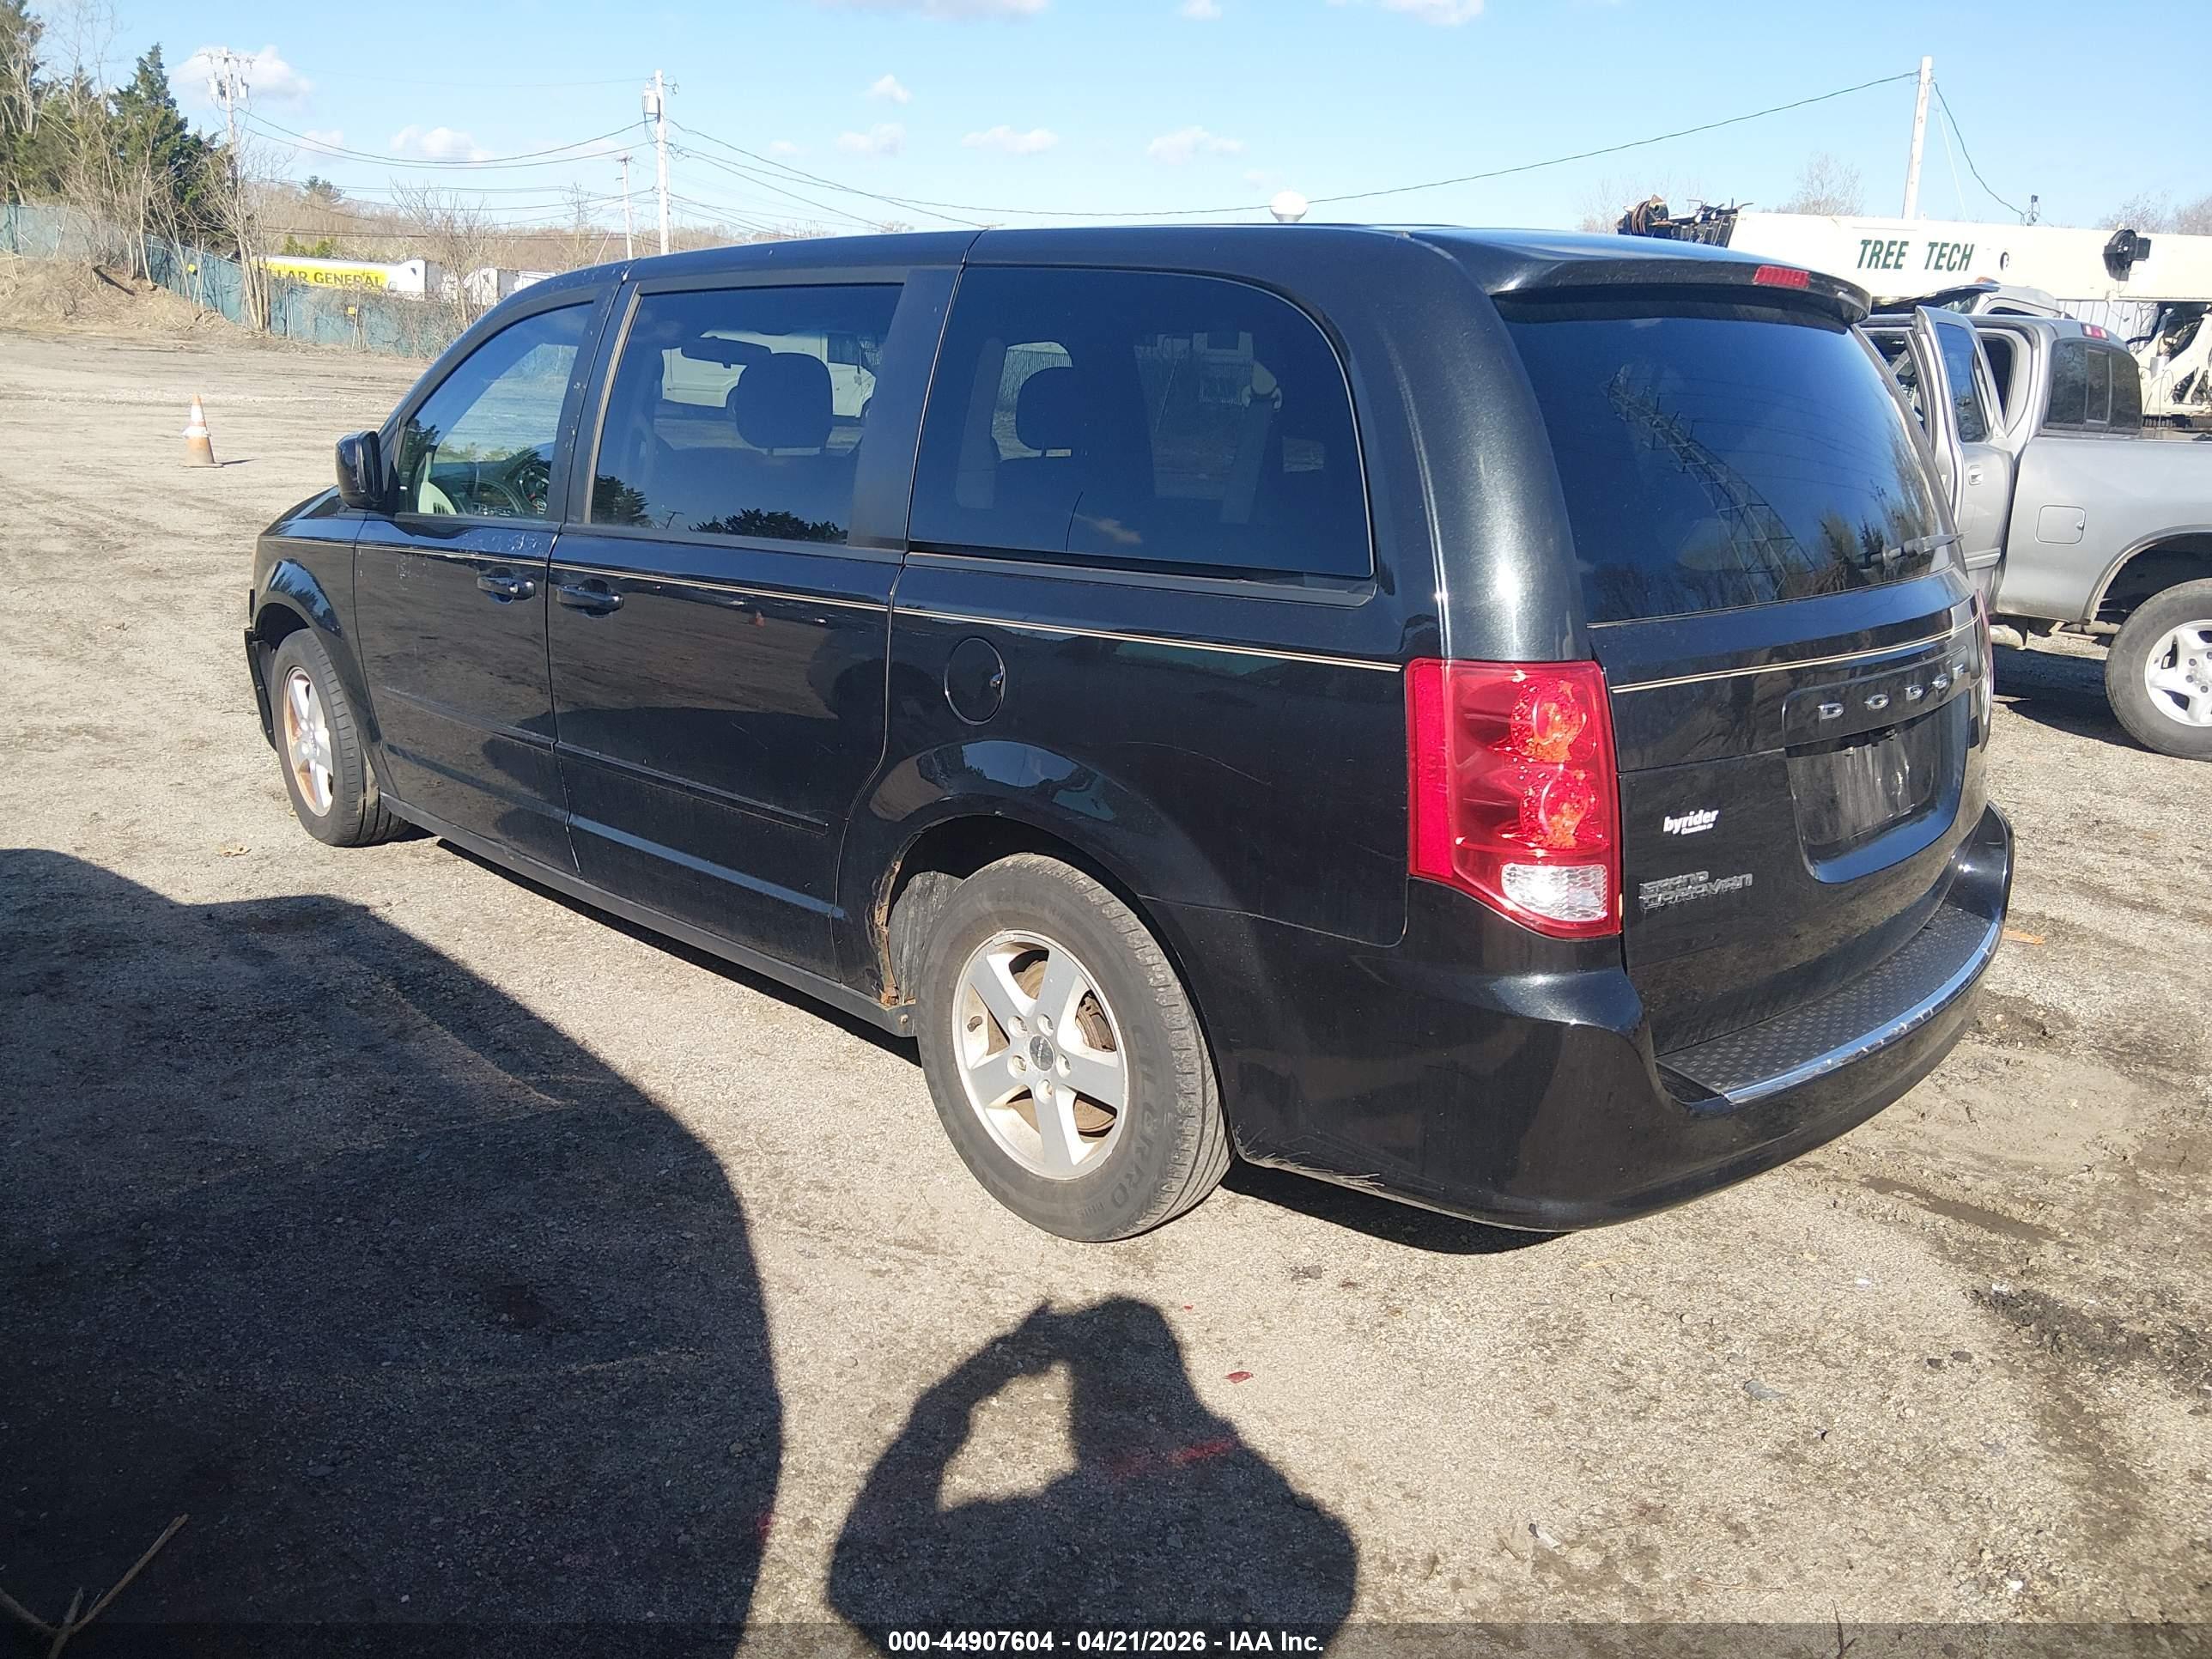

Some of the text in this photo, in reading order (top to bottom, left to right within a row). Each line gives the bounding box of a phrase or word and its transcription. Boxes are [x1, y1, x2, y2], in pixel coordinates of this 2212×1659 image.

[1856, 239, 1975, 271] TREE TECH
[313, 271, 383, 288] GENERAL
[1816, 663, 1966, 720] DODGE
[1662, 809, 1719, 835] byrider
